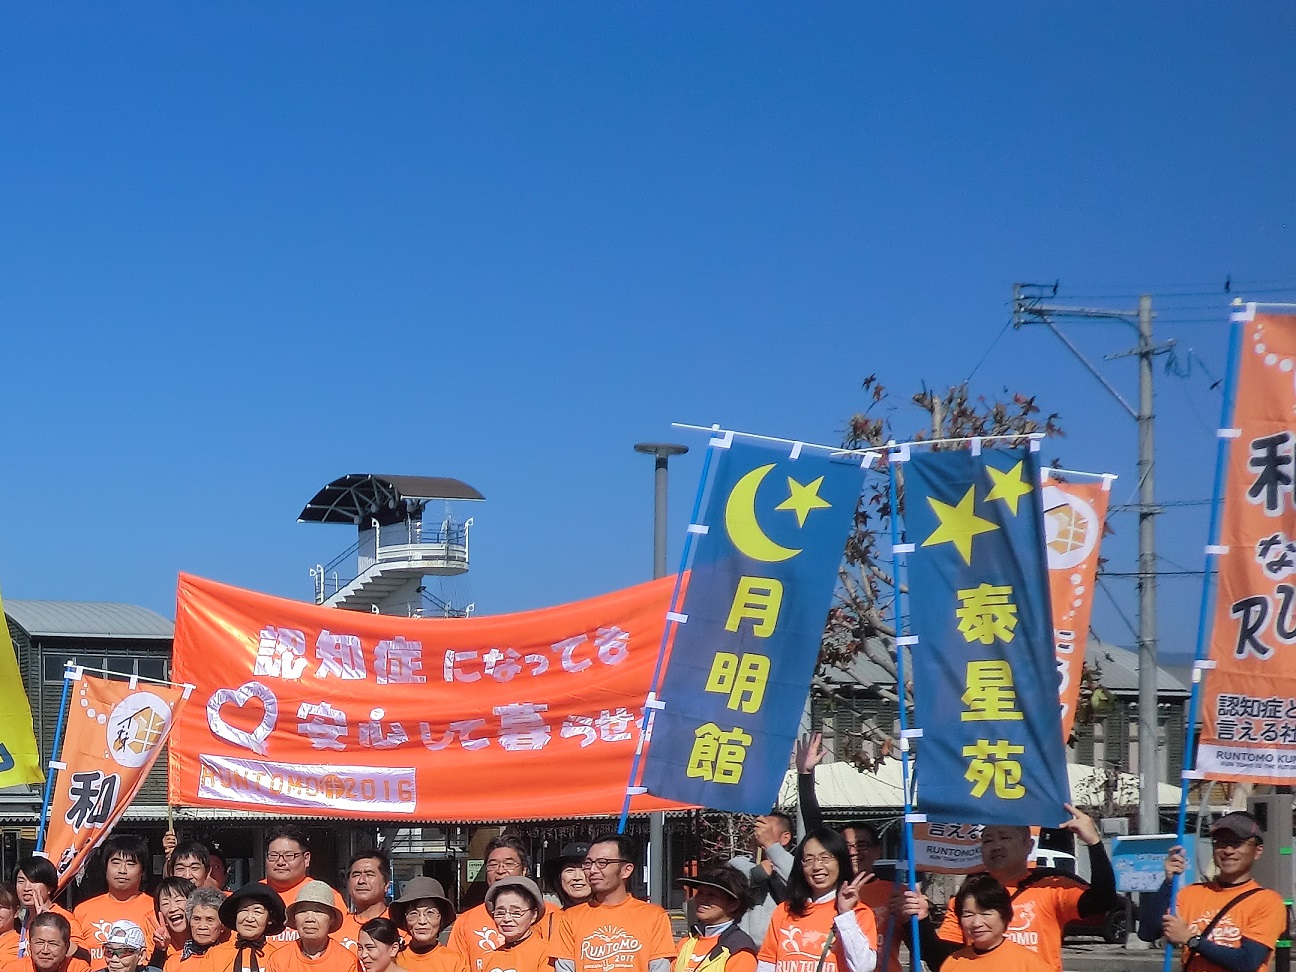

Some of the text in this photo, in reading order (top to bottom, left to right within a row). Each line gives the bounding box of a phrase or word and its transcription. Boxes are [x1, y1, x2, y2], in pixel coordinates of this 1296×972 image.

[686, 575, 785, 785] 月明館
[955, 582, 1026, 799] 泰星苑
[296, 702, 647, 751] 安心して暮らせ
[1215, 750, 1274, 763] RUNTOMO
[344, 777, 413, 802] 2016
[580, 939, 643, 957] RUNTOMO
[776, 961, 798, 972] RUN
